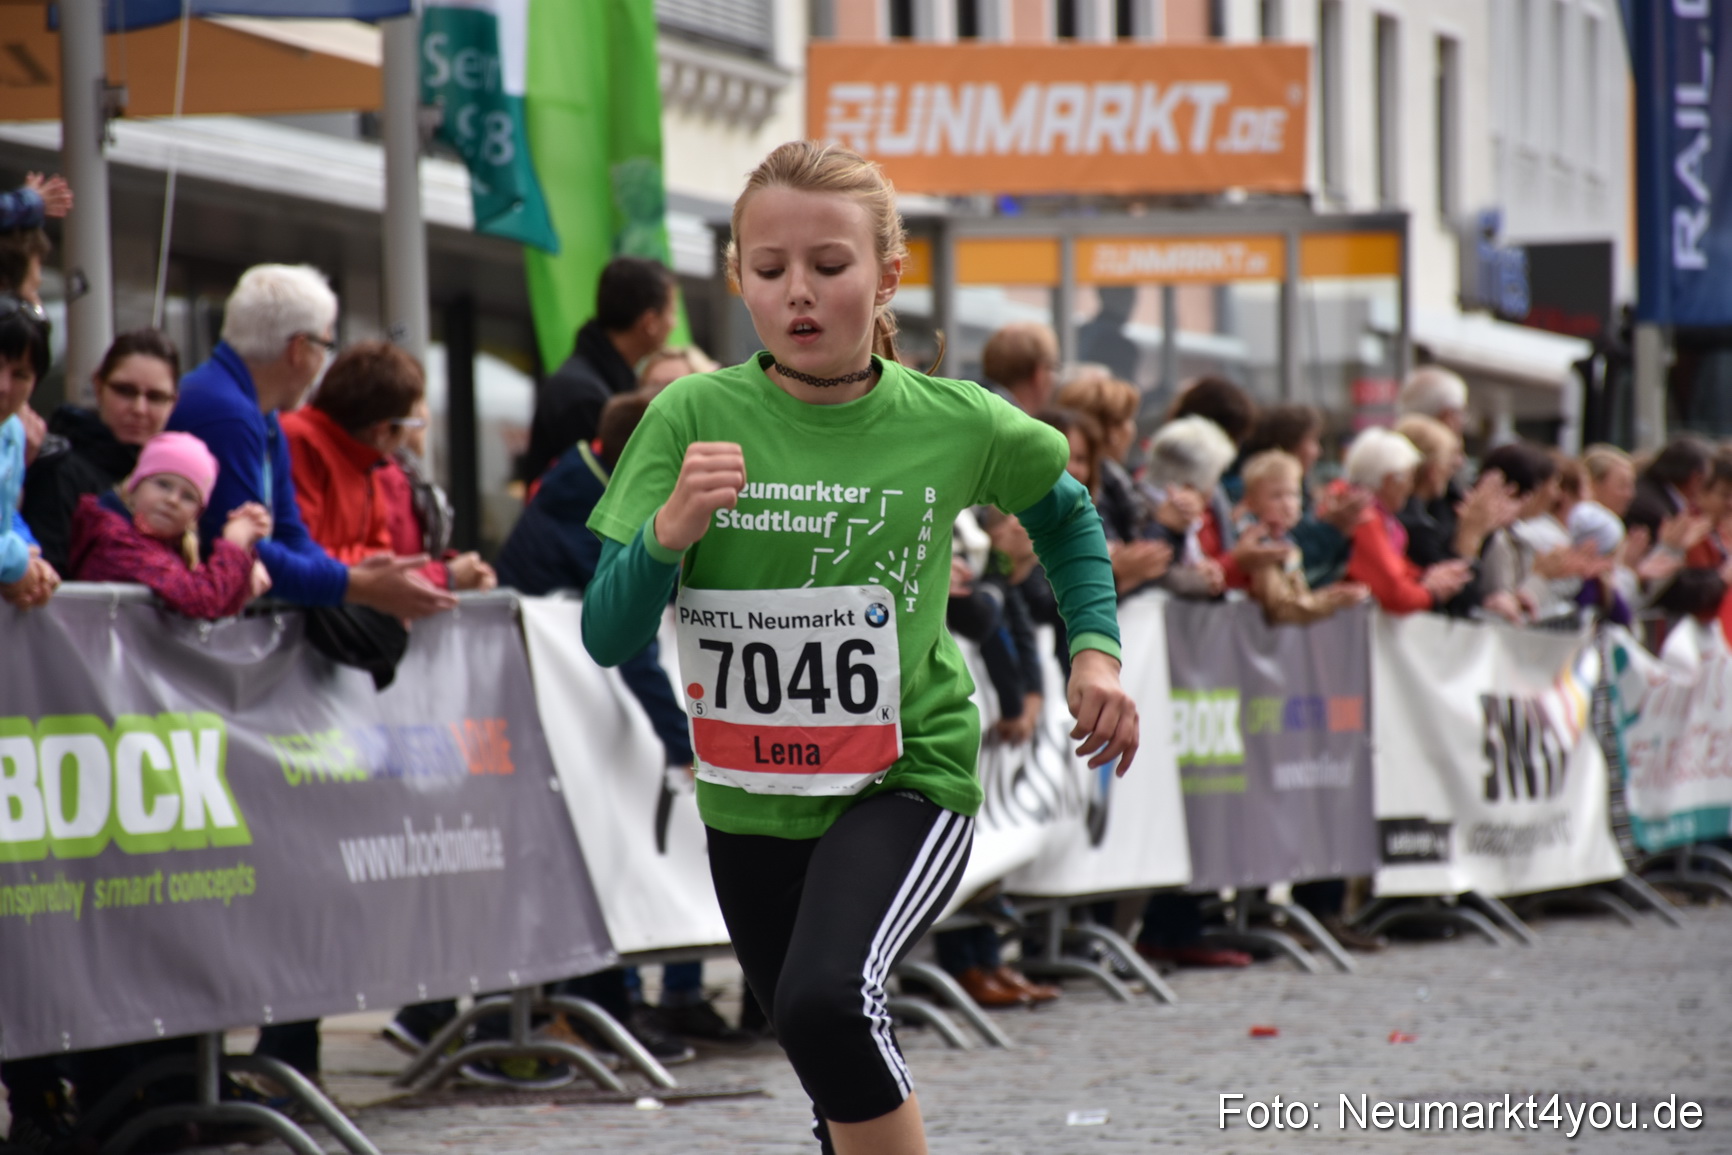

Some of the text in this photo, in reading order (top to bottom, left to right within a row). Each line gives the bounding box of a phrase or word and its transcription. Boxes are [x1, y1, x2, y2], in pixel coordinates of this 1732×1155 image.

[824, 81, 1288, 156] RUNMARKT.DE
[737, 480, 871, 504] eumarkter
[715, 508, 839, 538] Stadtlauf
[679, 607, 856, 630] PARTL Neumarkt
[698, 638, 879, 715] 7046
[695, 702, 704, 716] 5
[881, 707, 891, 721] K
[753, 735, 822, 766] Lena
[93, 869, 163, 909] smart
